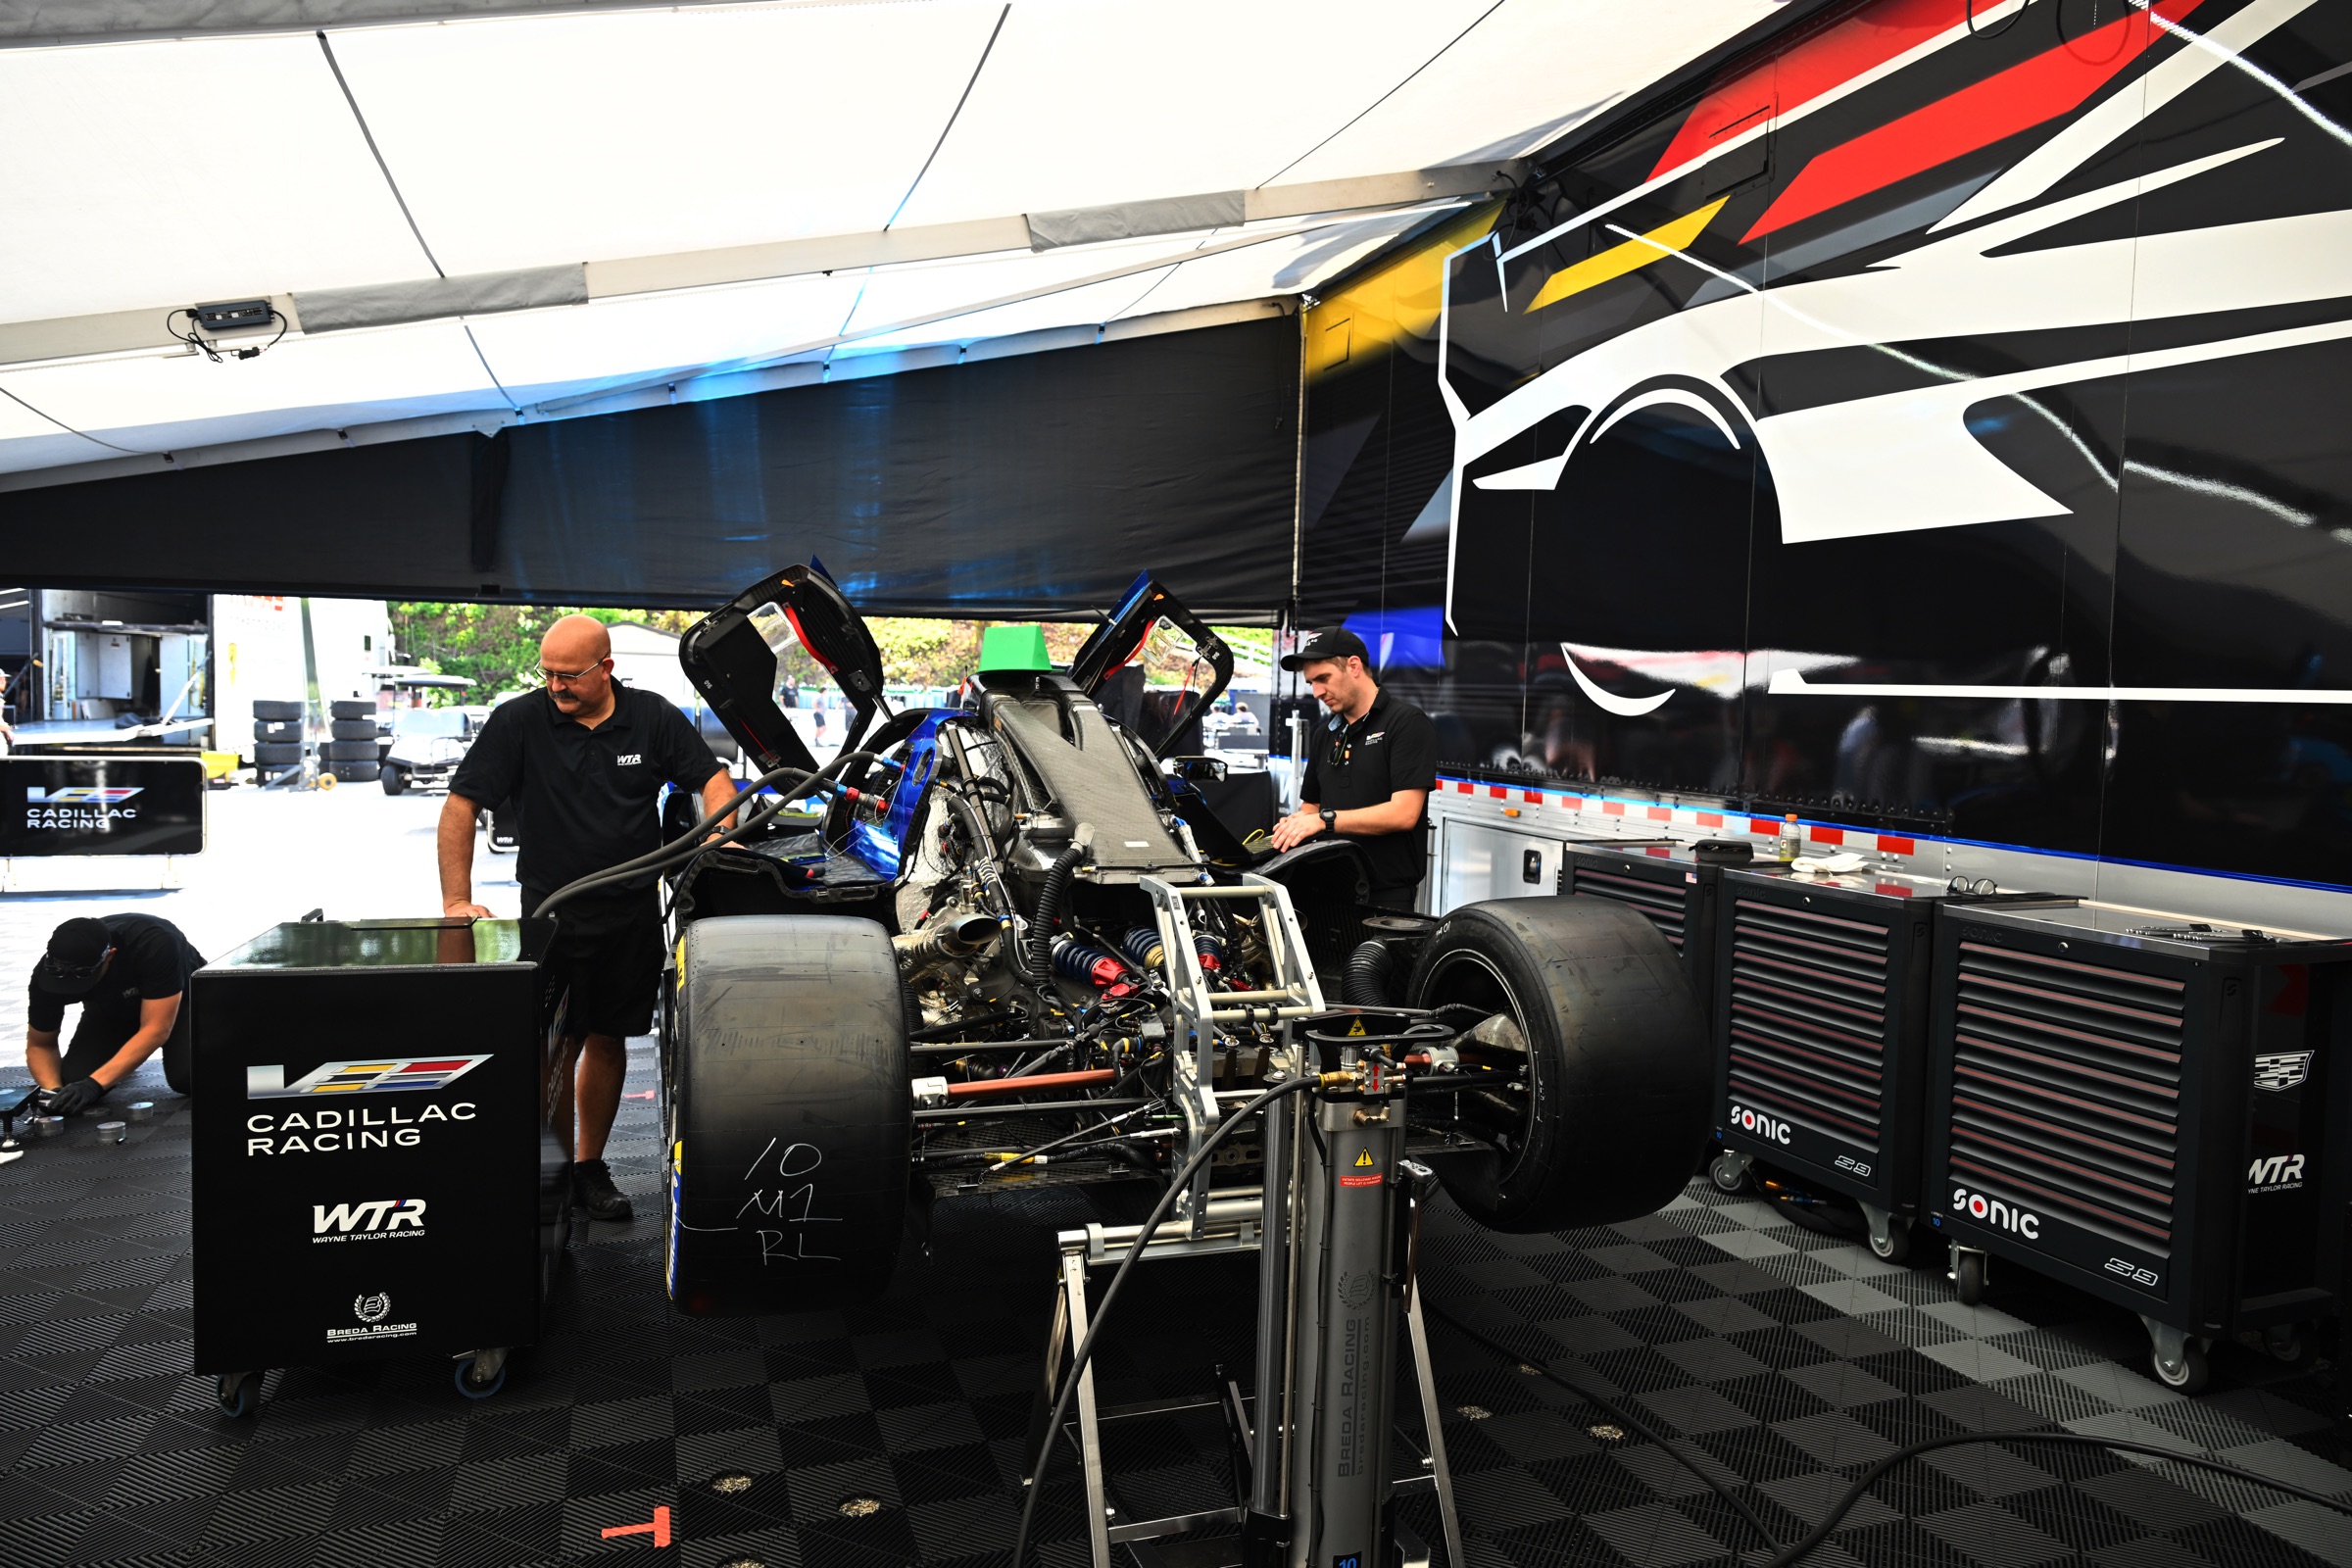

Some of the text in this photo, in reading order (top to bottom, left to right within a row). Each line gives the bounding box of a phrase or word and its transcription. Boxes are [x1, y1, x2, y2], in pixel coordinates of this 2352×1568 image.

[617, 754, 642, 764] WTR
[26, 808, 137, 819] CADILLAC
[26, 818, 110, 829] RACING
[246, 1102, 477, 1133] CADILLAC
[247, 1128, 421, 1156] RACING
[744, 1137, 822, 1181] 10
[313, 1199, 426, 1234] WTR
[312, 1229, 425, 1244] WAYNE TAYLOR RACING
[756, 1229, 842, 1265] RL
[2104, 1257, 2159, 1287] S9
[326, 1322, 417, 1337] BREDA RACING
[326, 1331, 417, 1344] www.bredaracing.com
[1338, 1318, 1357, 1478] BREDA RACING
[1357, 1315, 1370, 1476] bredaracing.com
